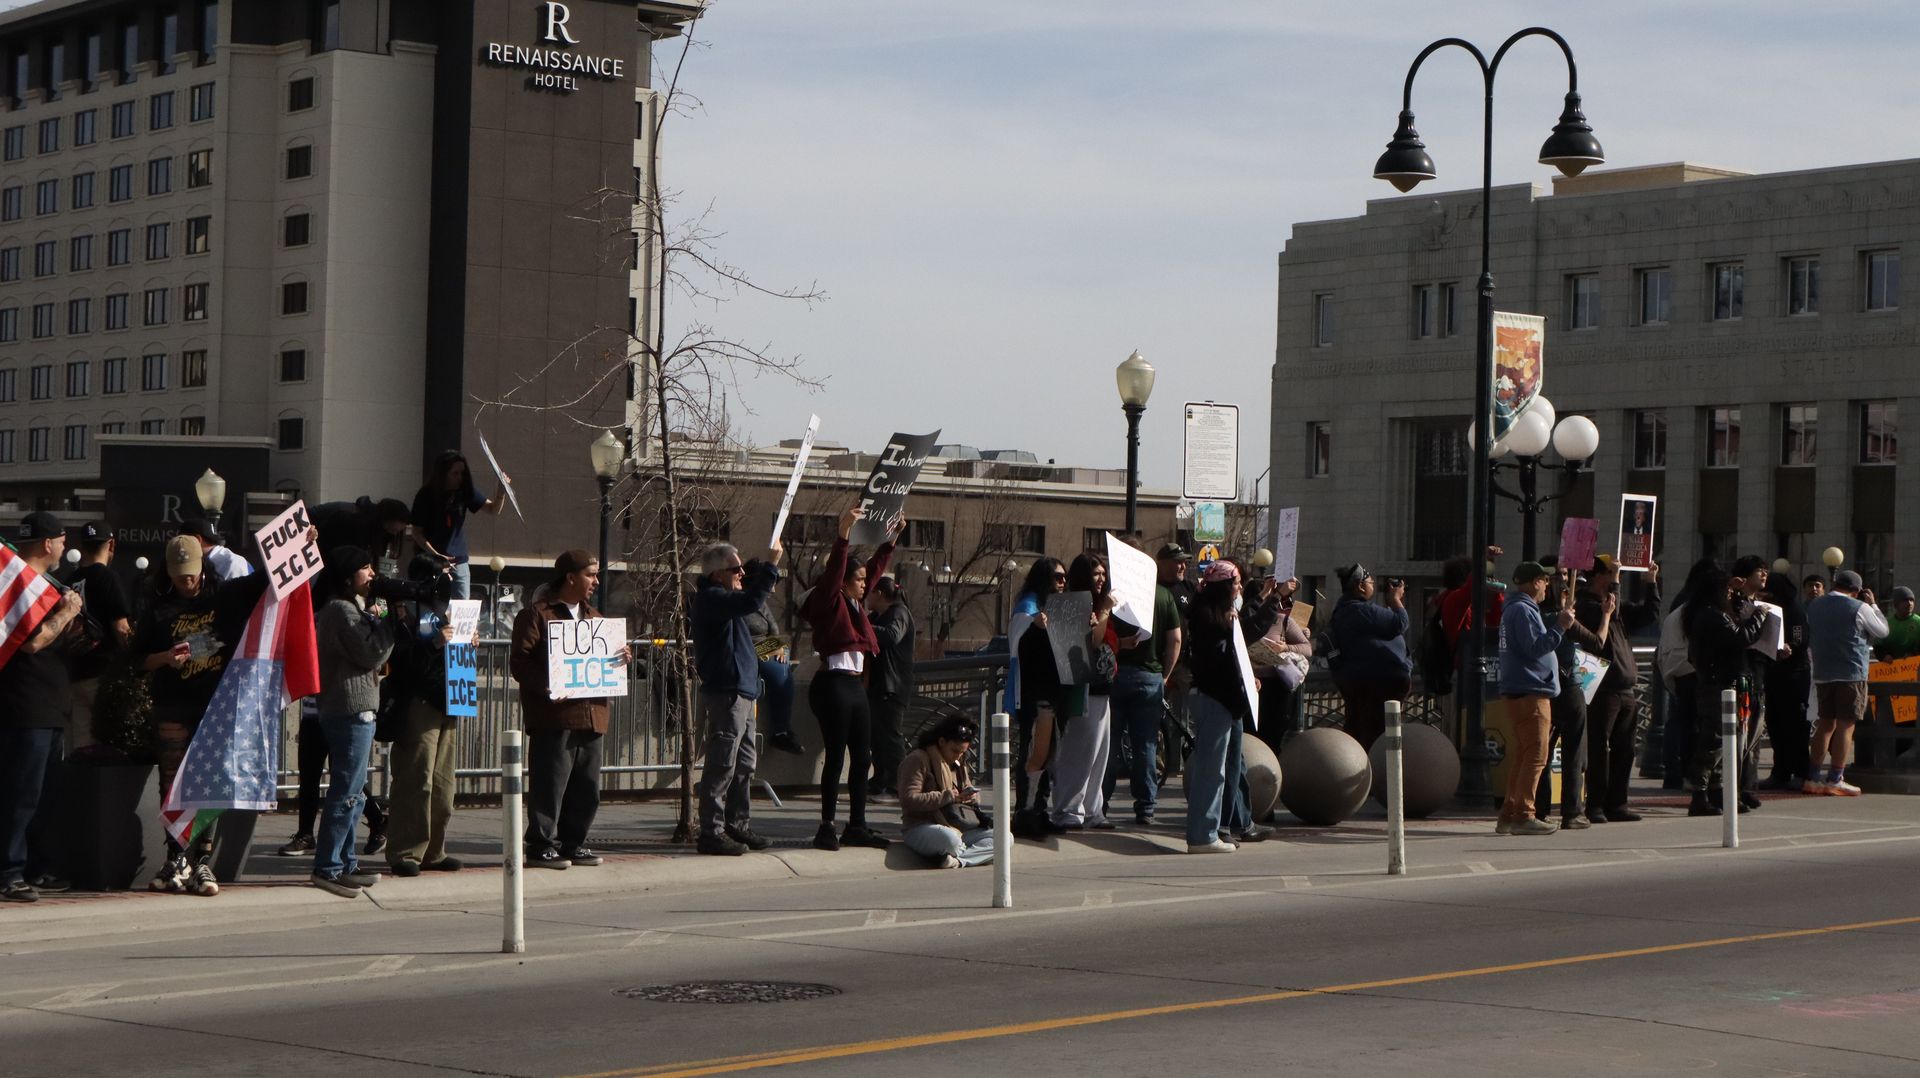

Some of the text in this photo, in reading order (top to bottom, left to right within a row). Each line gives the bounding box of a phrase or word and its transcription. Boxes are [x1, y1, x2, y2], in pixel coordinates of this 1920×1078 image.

[544, 1, 580, 44] R
[489, 43, 624, 77] RENAISSANCE
[535, 73, 579, 91] HOTEL
[162, 494, 184, 523] R
[261, 507, 310, 560] FUCK
[271, 541, 320, 589] ICE
[455, 621, 474, 635] ICE
[549, 619, 608, 655] FUCK
[448, 643, 476, 669] FUCK
[564, 657, 618, 689] ICE
[449, 678, 477, 706] ICE
